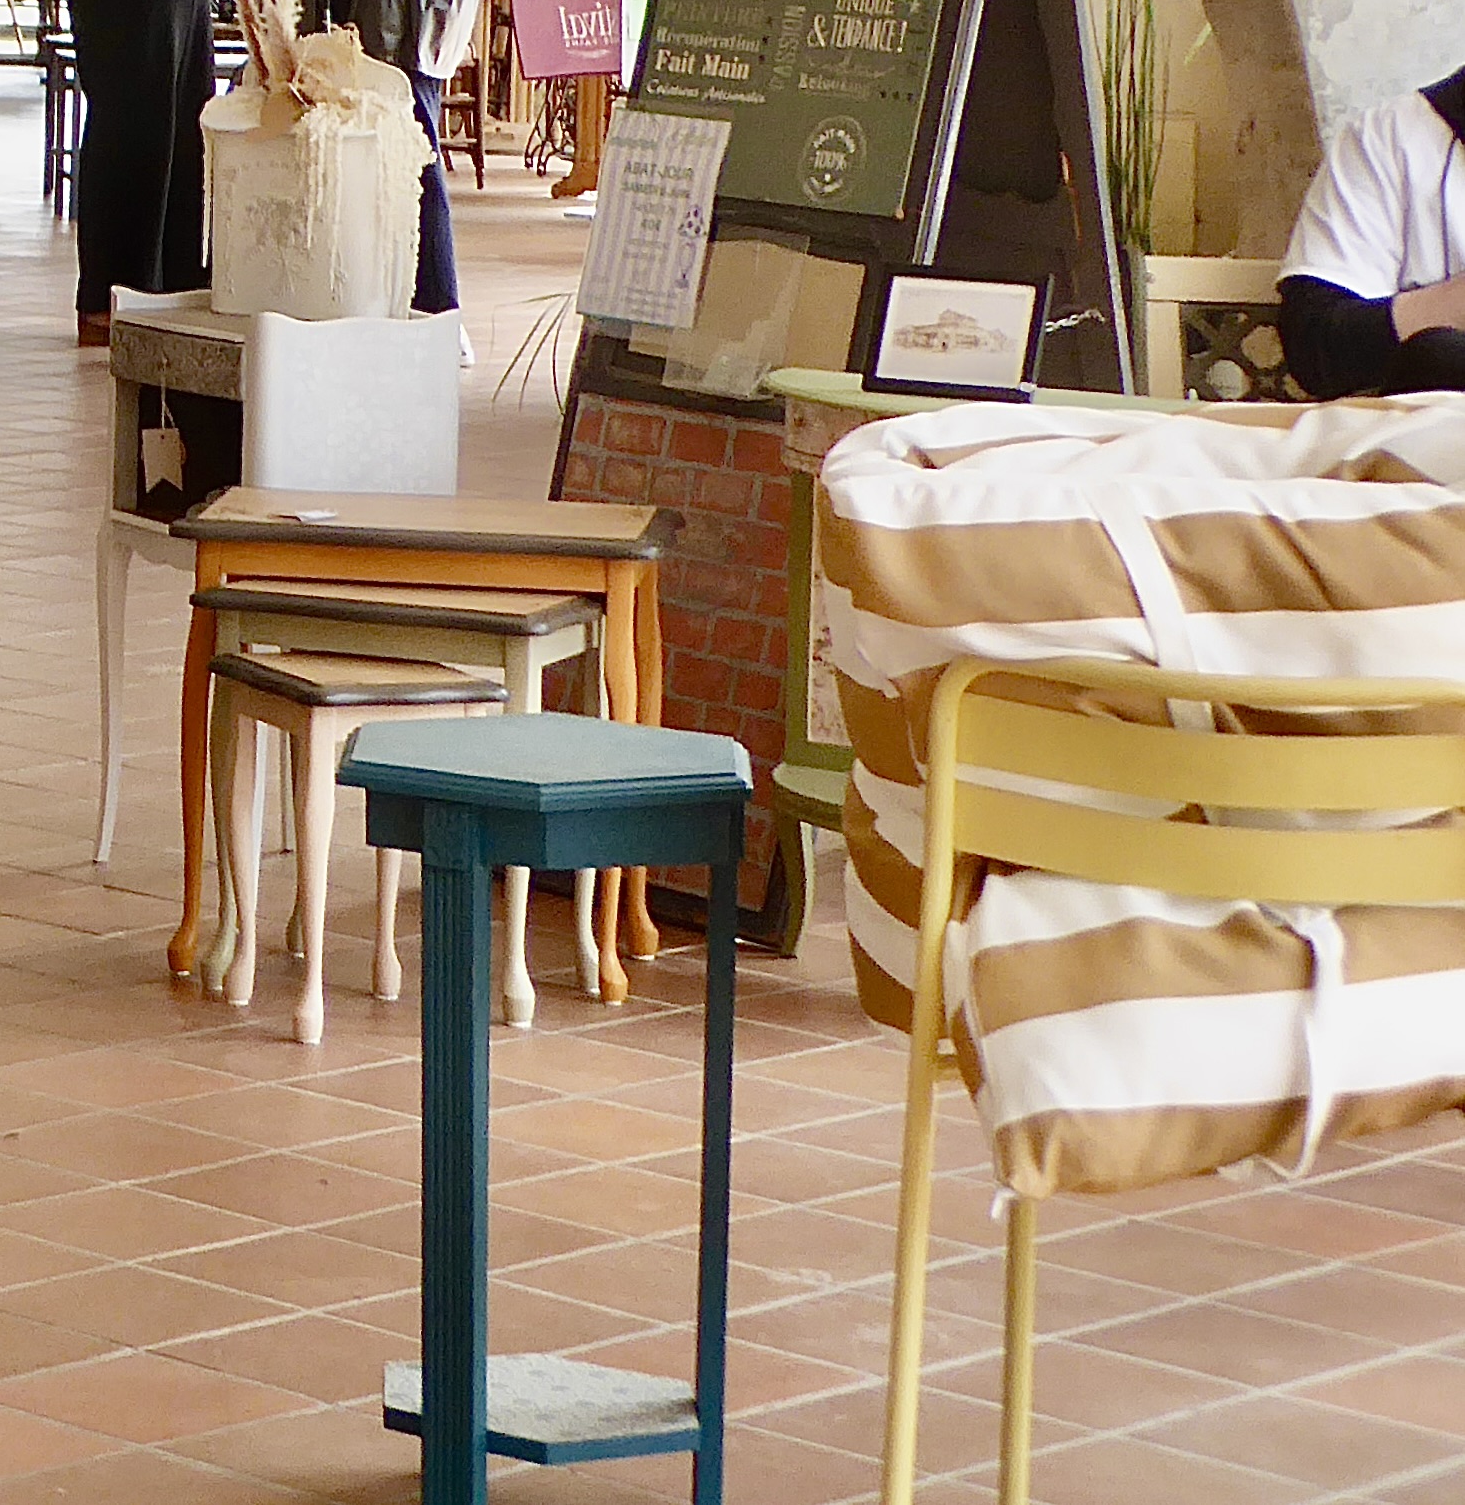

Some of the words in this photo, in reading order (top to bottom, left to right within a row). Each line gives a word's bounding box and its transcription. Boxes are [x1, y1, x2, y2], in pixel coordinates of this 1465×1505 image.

[807, 14, 827, 48] &
[655, 48, 696, 75] Fait
[701, 52, 751, 81] Main
[814, 150, 848, 172] 100%
